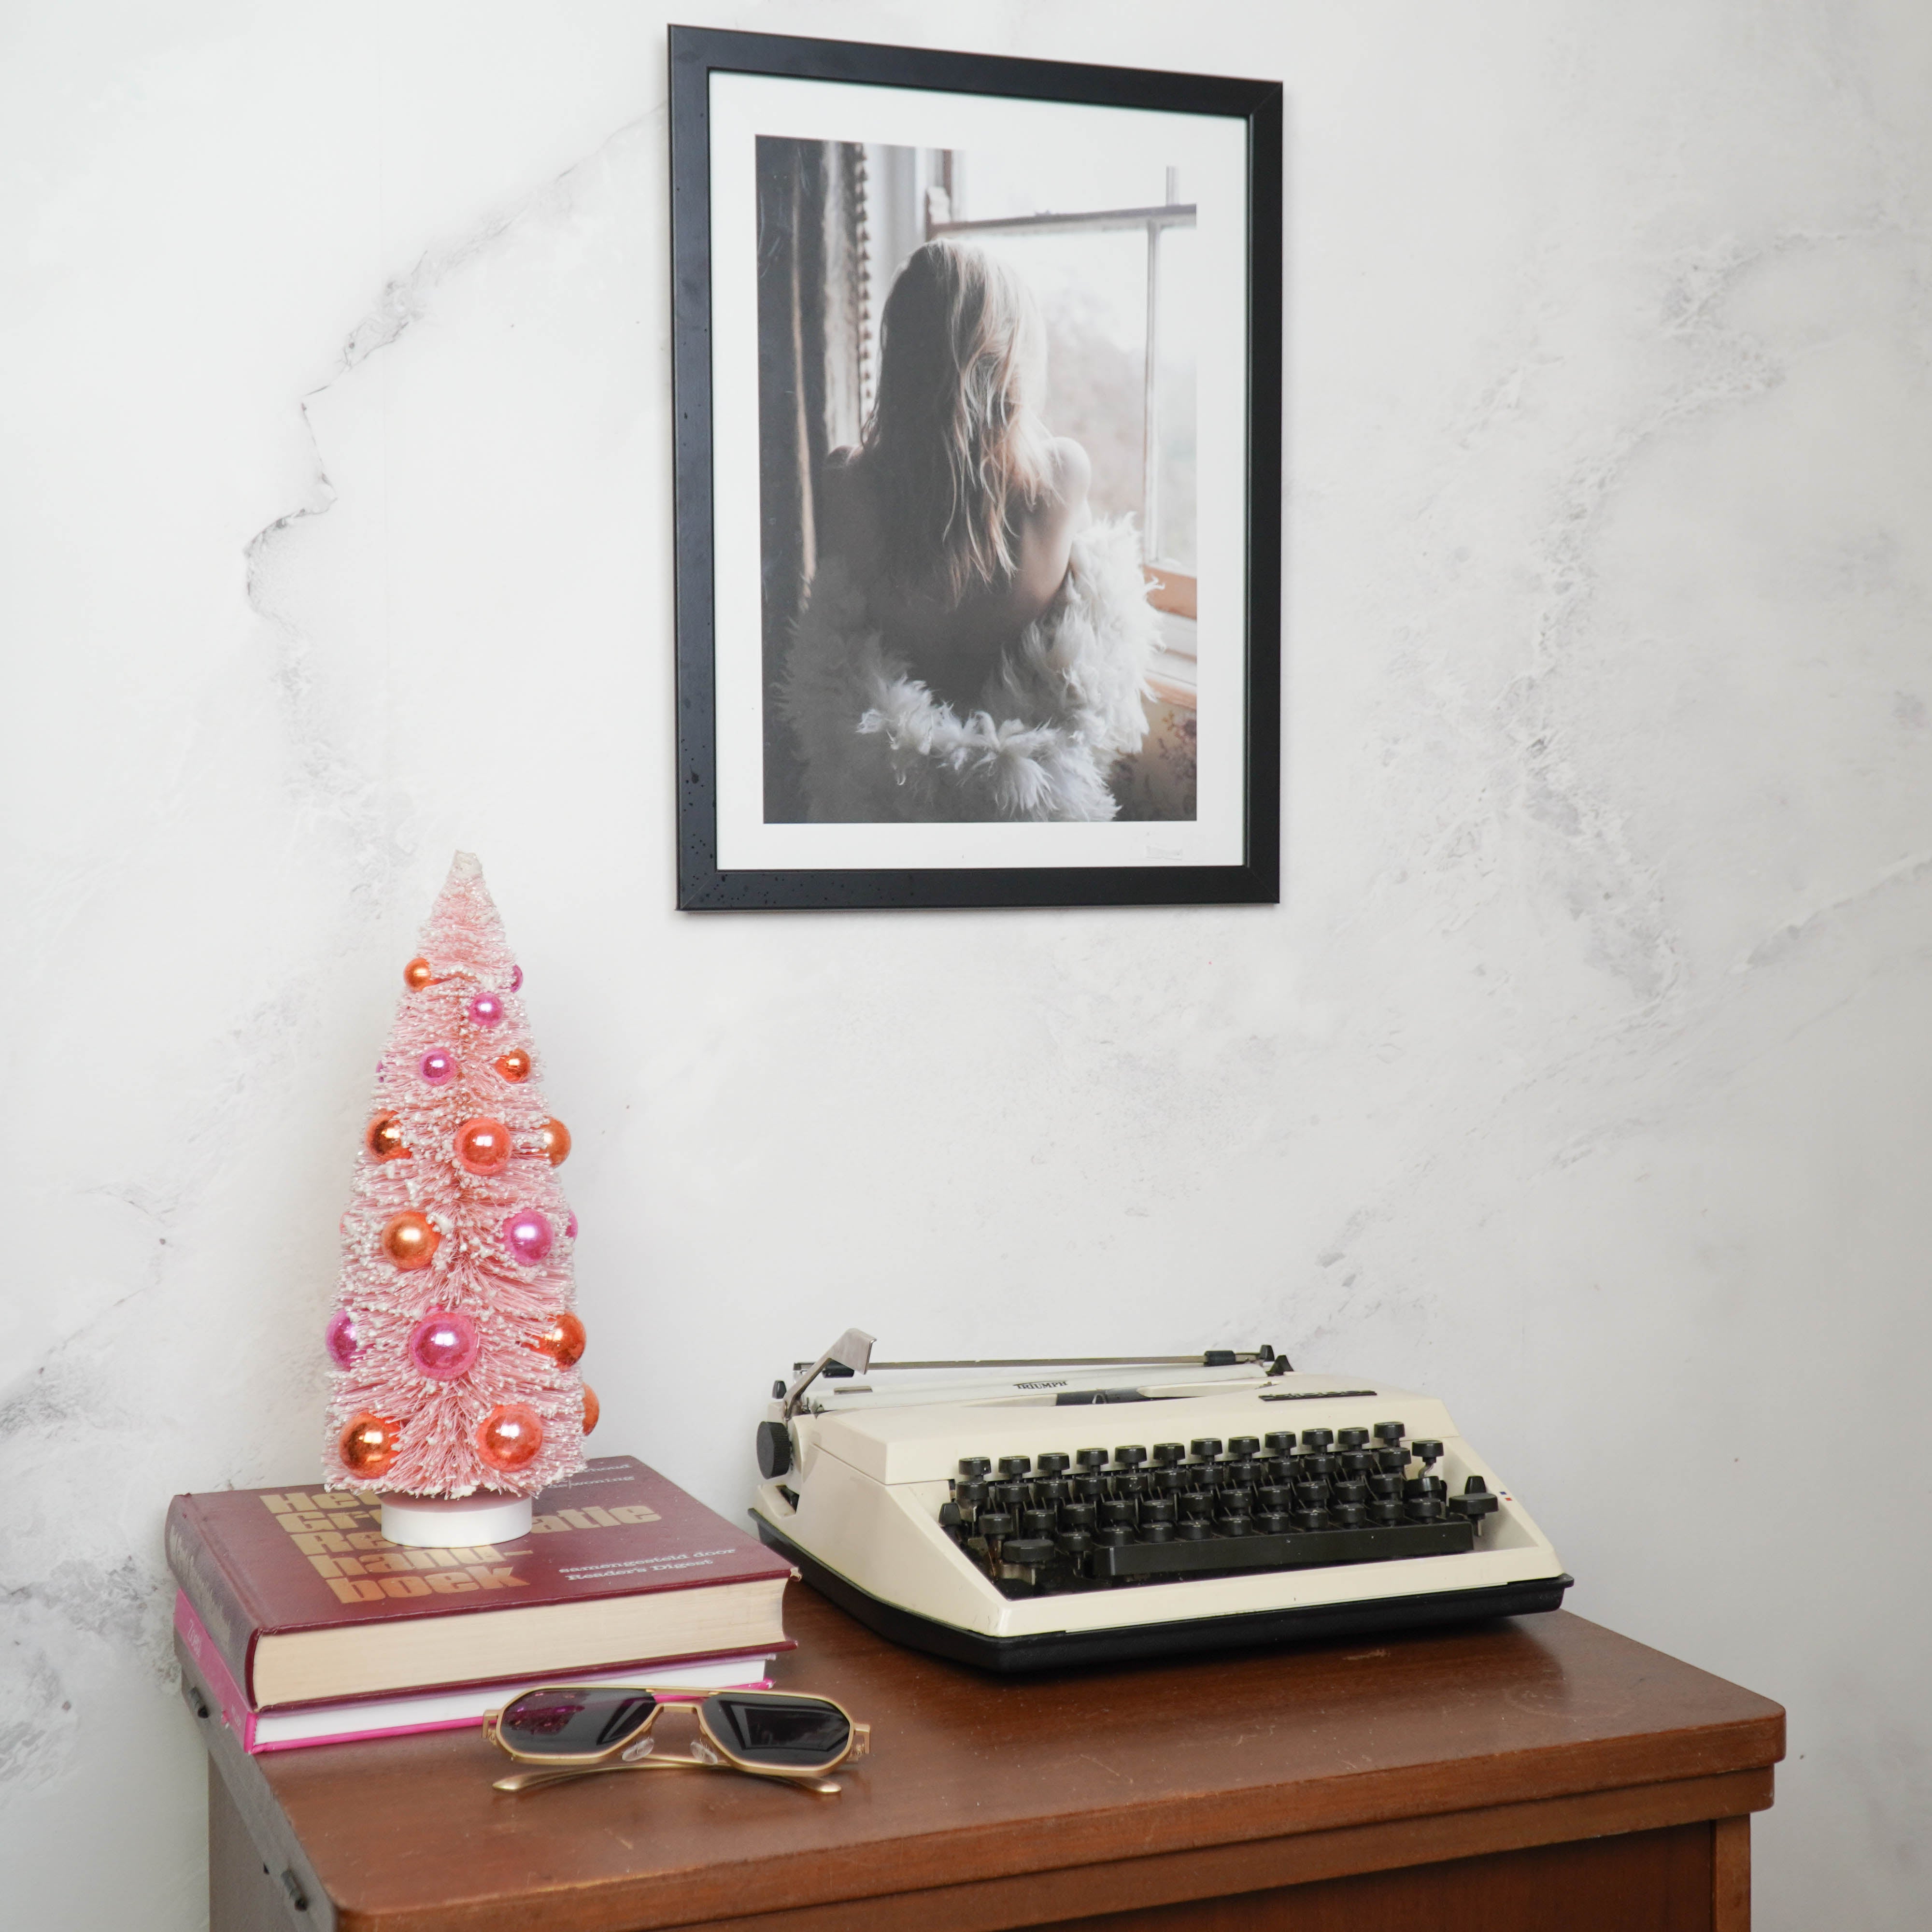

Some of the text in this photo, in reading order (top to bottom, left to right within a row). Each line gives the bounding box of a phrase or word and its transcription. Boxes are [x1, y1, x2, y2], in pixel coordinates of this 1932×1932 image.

[1012, 1380, 1068, 1389] TRIUMPH
[571, 1476, 635, 1487] woning
[558, 1549, 736, 1574] samengesteld door
[565, 1560, 714, 1581] Reader's Digest
[325, 1565, 531, 1604] boek
